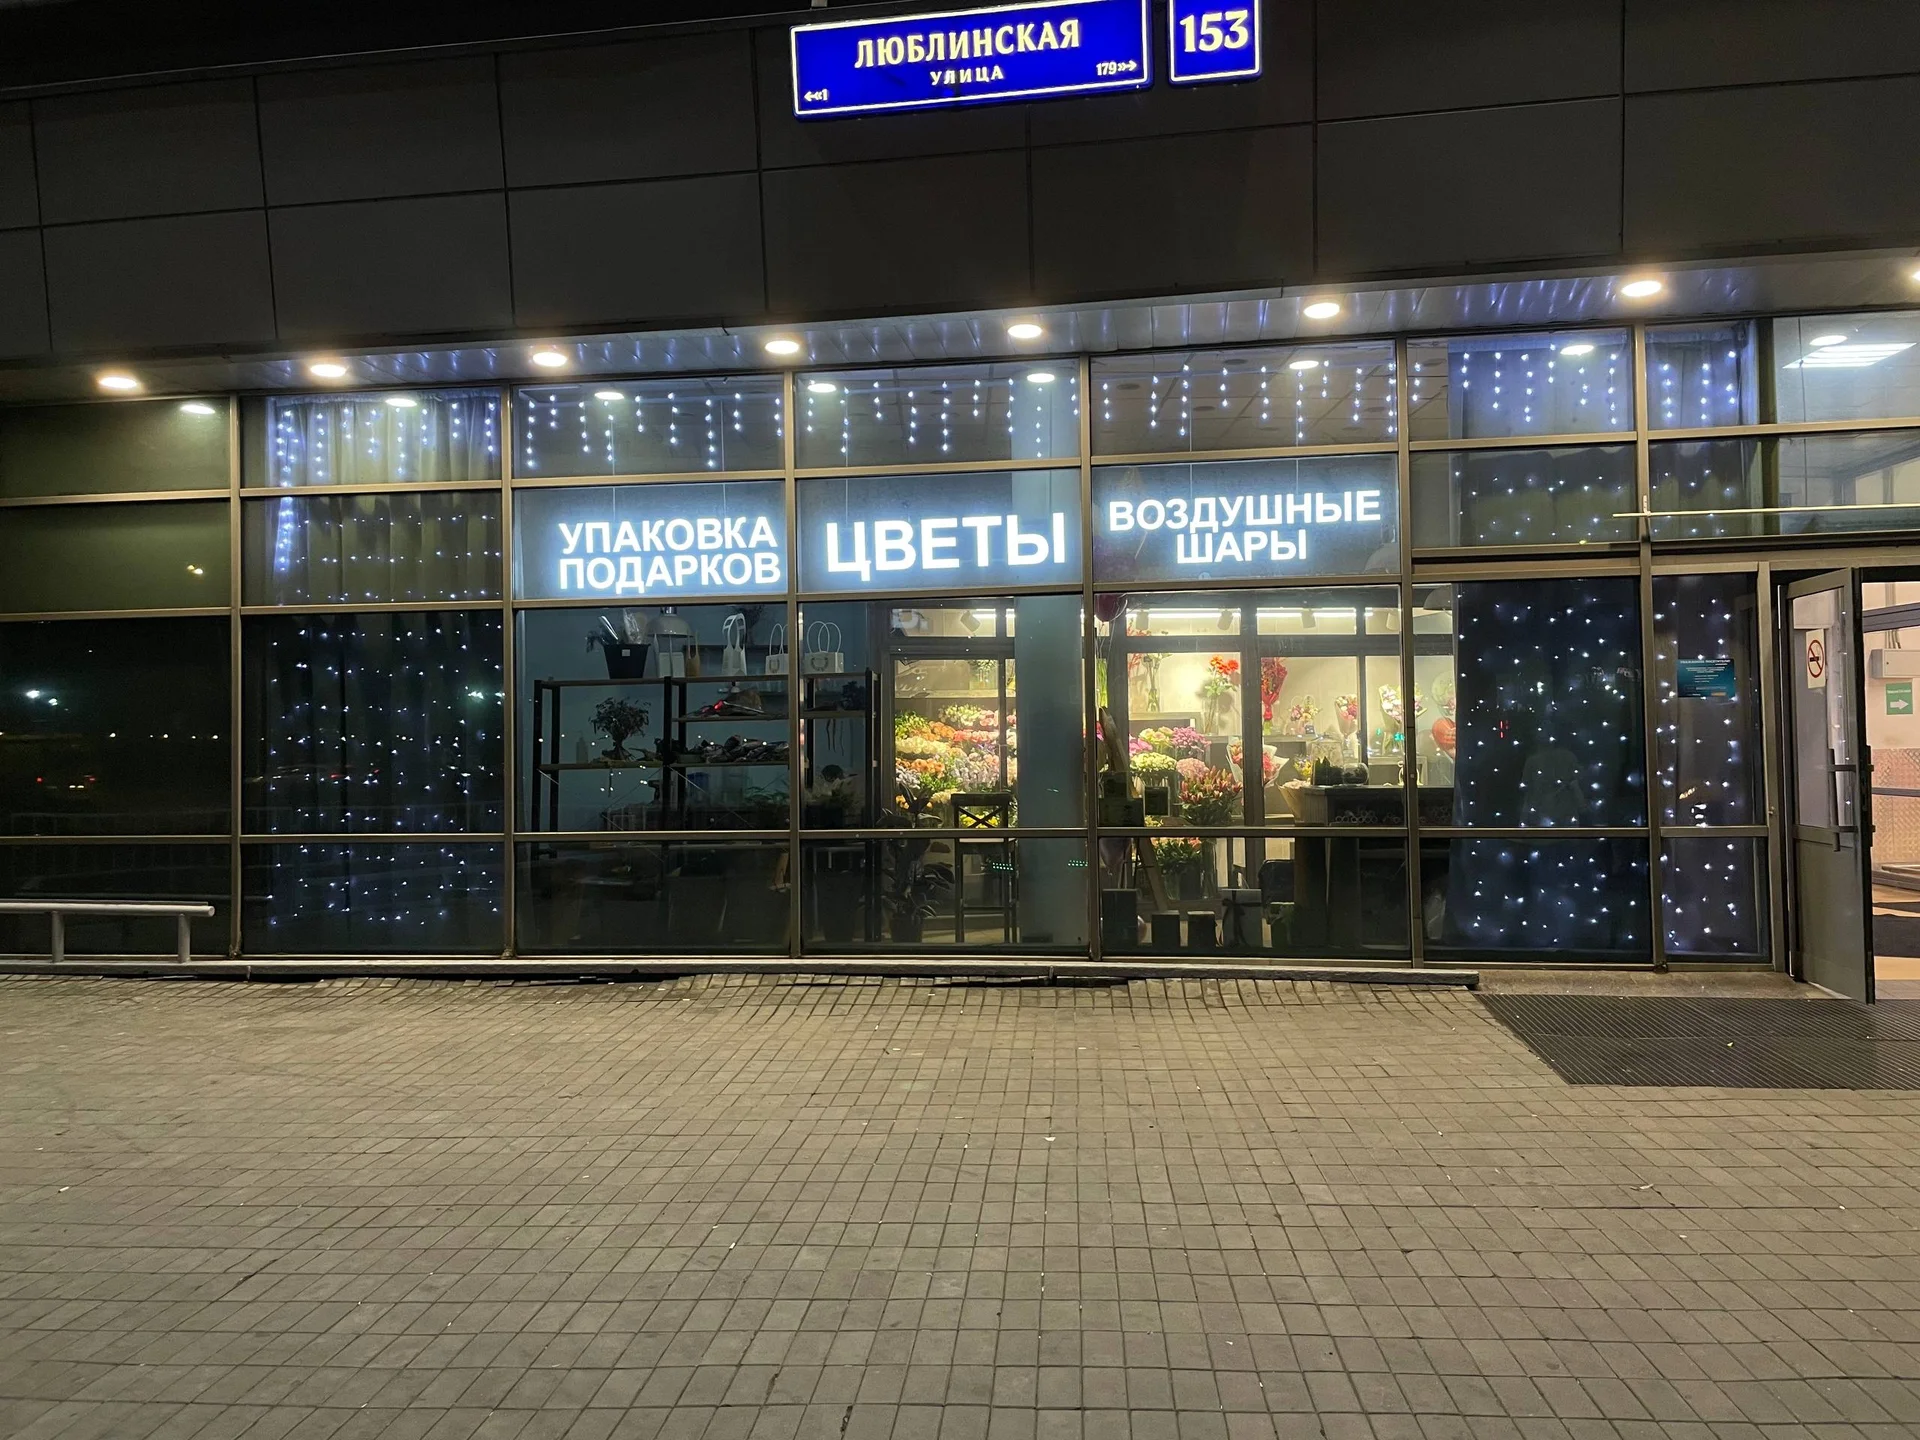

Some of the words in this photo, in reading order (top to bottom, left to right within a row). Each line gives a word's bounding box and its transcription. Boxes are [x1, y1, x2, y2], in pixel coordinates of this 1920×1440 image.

[854, 19, 1080, 68] ЛЮБЛИНСКАЯ
[1180, 9, 1249, 53] 153
[930, 65, 1005, 86] УЛИЦА
[1096, 61, 1117, 76] 179
[821, 88, 828, 101] 1
[1109, 490, 1381, 533] ВОЗДУШНЫЕ
[558, 516, 778, 554] УПАКОВКА
[826, 511, 1066, 581] ЦВЕТЫ
[1176, 529, 1307, 564] ШАРЫ
[558, 552, 780, 594] ПОДАРКОВ
